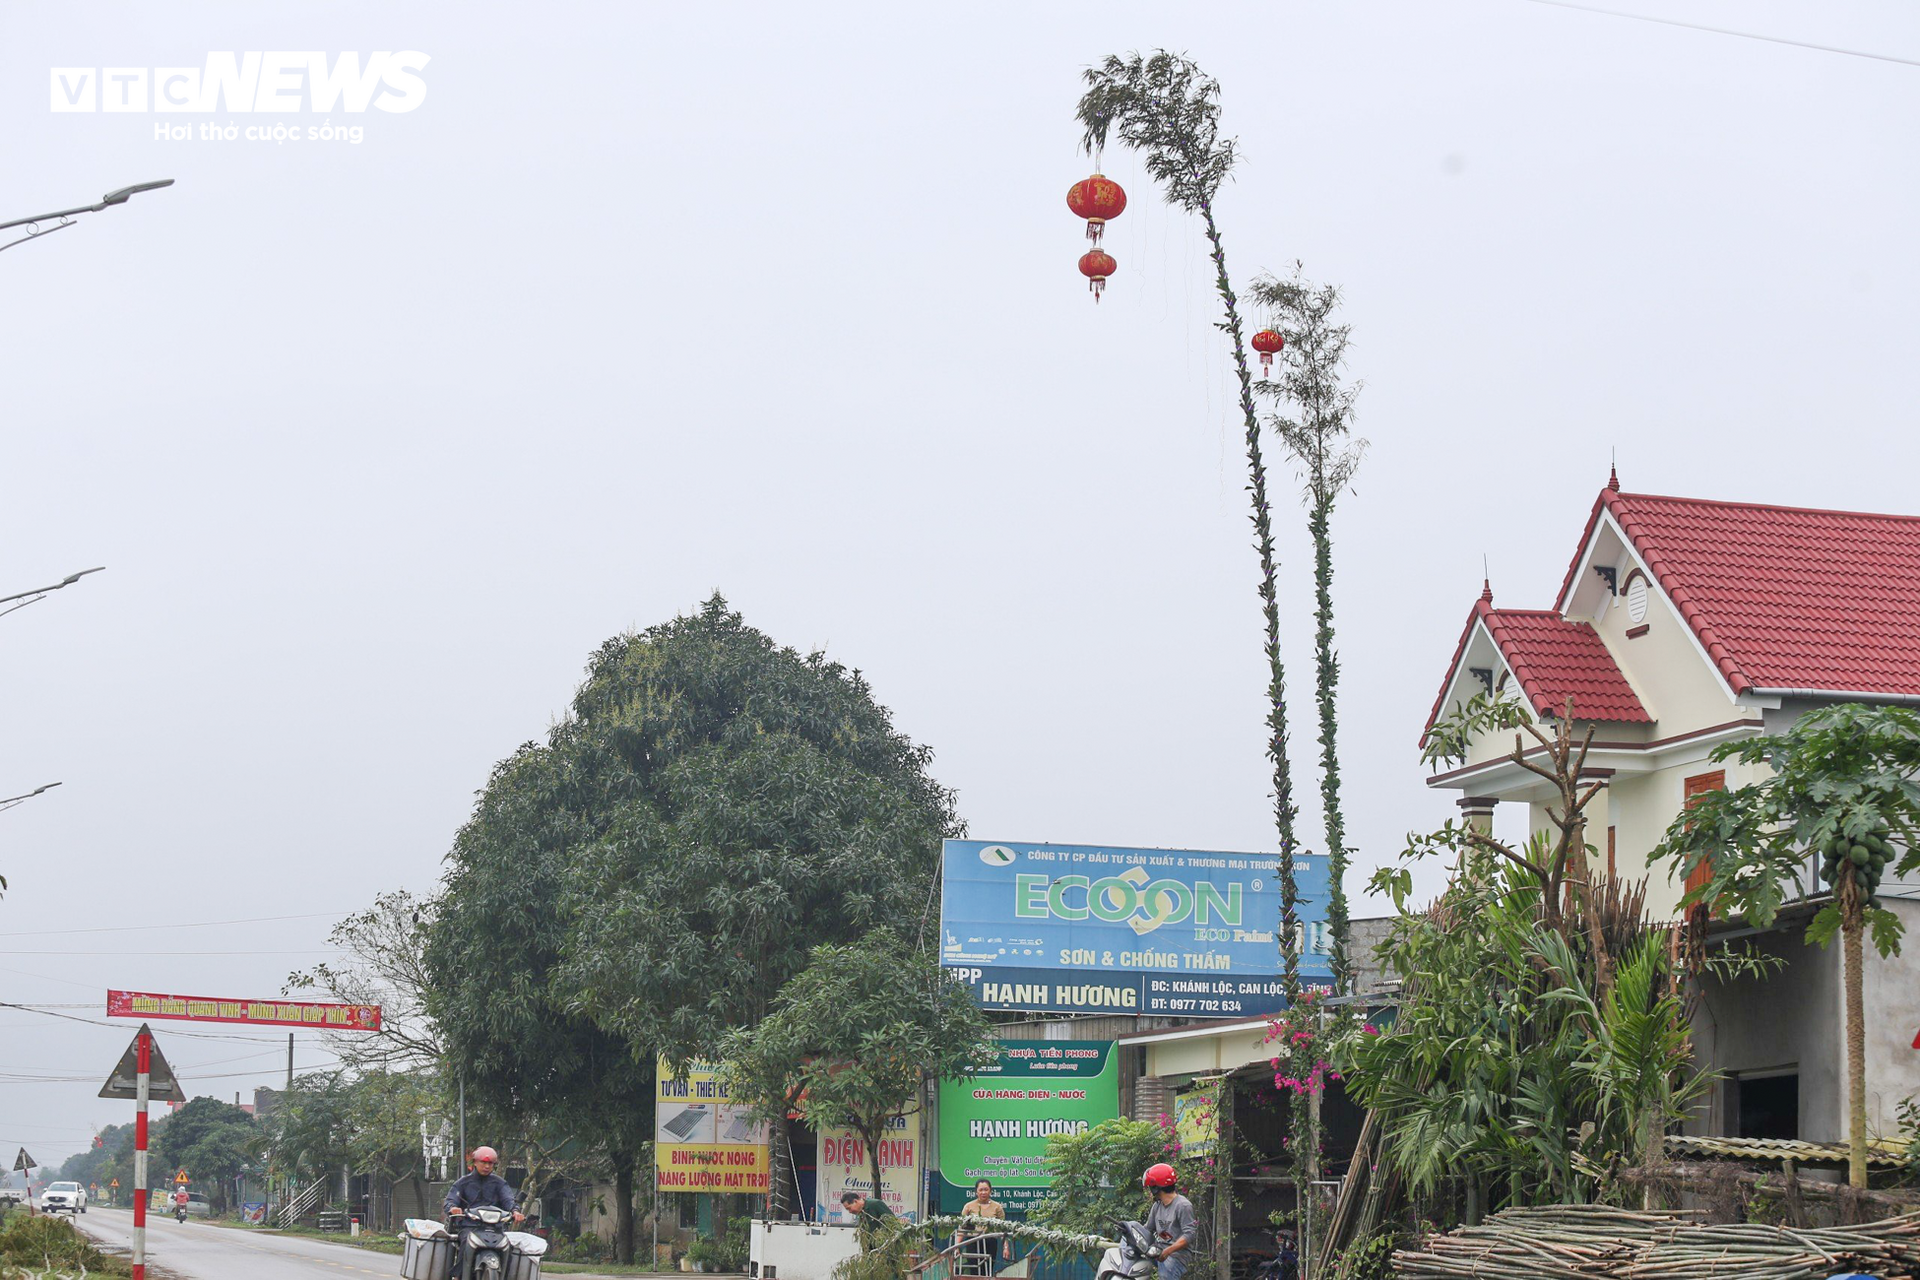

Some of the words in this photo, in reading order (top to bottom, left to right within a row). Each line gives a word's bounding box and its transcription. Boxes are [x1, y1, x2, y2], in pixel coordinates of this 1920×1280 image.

[1027, 849, 1055, 861] CÔNG
[1058, 852, 1069, 862] TY
[1072, 852, 1086, 862] CP
[1112, 854, 1125, 864] TƯ
[1126, 852, 1146, 865] SẢN
[1149, 853, 1175, 866] XUẤT
[1177, 857, 1185, 867] &
[1187, 857, 1226, 869] THƯƠNG
[1228, 859, 1247, 871] MẠI
[1194, 928, 1231, 943] ECO
[1233, 928, 1274, 943] Paint
[1060, 948, 1098, 966] SƠN
[1101, 952, 1114, 967] &
[1119, 946, 1179, 969] CHỐNG
[1183, 949, 1231, 970] THẤM
[982, 983, 1049, 1008] HẠNH
[1056, 984, 1137, 1008] HƯƠNG
[1151, 980, 1170, 993] ĐC:
[1172, 979, 1210, 994] KHÁNH
[1212, 980, 1236, 996] LỘC,
[1238, 983, 1261, 995] CAN
[1263, 981, 1287, 998] LỘC,
[187, 1000, 219, 1018] QUANG
[218, 1002, 242, 1019] VINH
[275, 1003, 303, 1022] XUÂN
[302, 1004, 325, 1023] GIÁP
[1151, 998, 1168, 1010] ĐT:
[1170, 999, 1196, 1011] 0977
[1199, 1000, 1220, 1011] 702
[1222, 1000, 1242, 1012] 634
[1008, 1047, 1037, 1060] NHỰA
[1065, 1049, 1099, 1059] PHONG
[661, 1080, 672, 1097] TƯ
[696, 1076, 718, 1098] THIẾT
[972, 1086, 994, 1100] CỬA
[995, 1088, 1026, 1100] HÀNG:
[1027, 1088, 1050, 1101] ĐIỆN
[1058, 1088, 1087, 1100] NƯỚC
[970, 1120, 1022, 1142] HẠNH
[727, 1147, 755, 1166] NÓNG
[823, 1130, 865, 1176] ĐIỆN
[877, 1138, 915, 1174] ẠNH
[659, 1169, 687, 1186] NĂNG
[964, 1168, 982, 1178] Gạch
[1024, 1168, 1038, 1178] Sơn
[1002, 1189, 1012, 1200] 10,
[1013, 1189, 1032, 1198] Khánh
[1033, 1189, 1045, 1200] Lộc,
